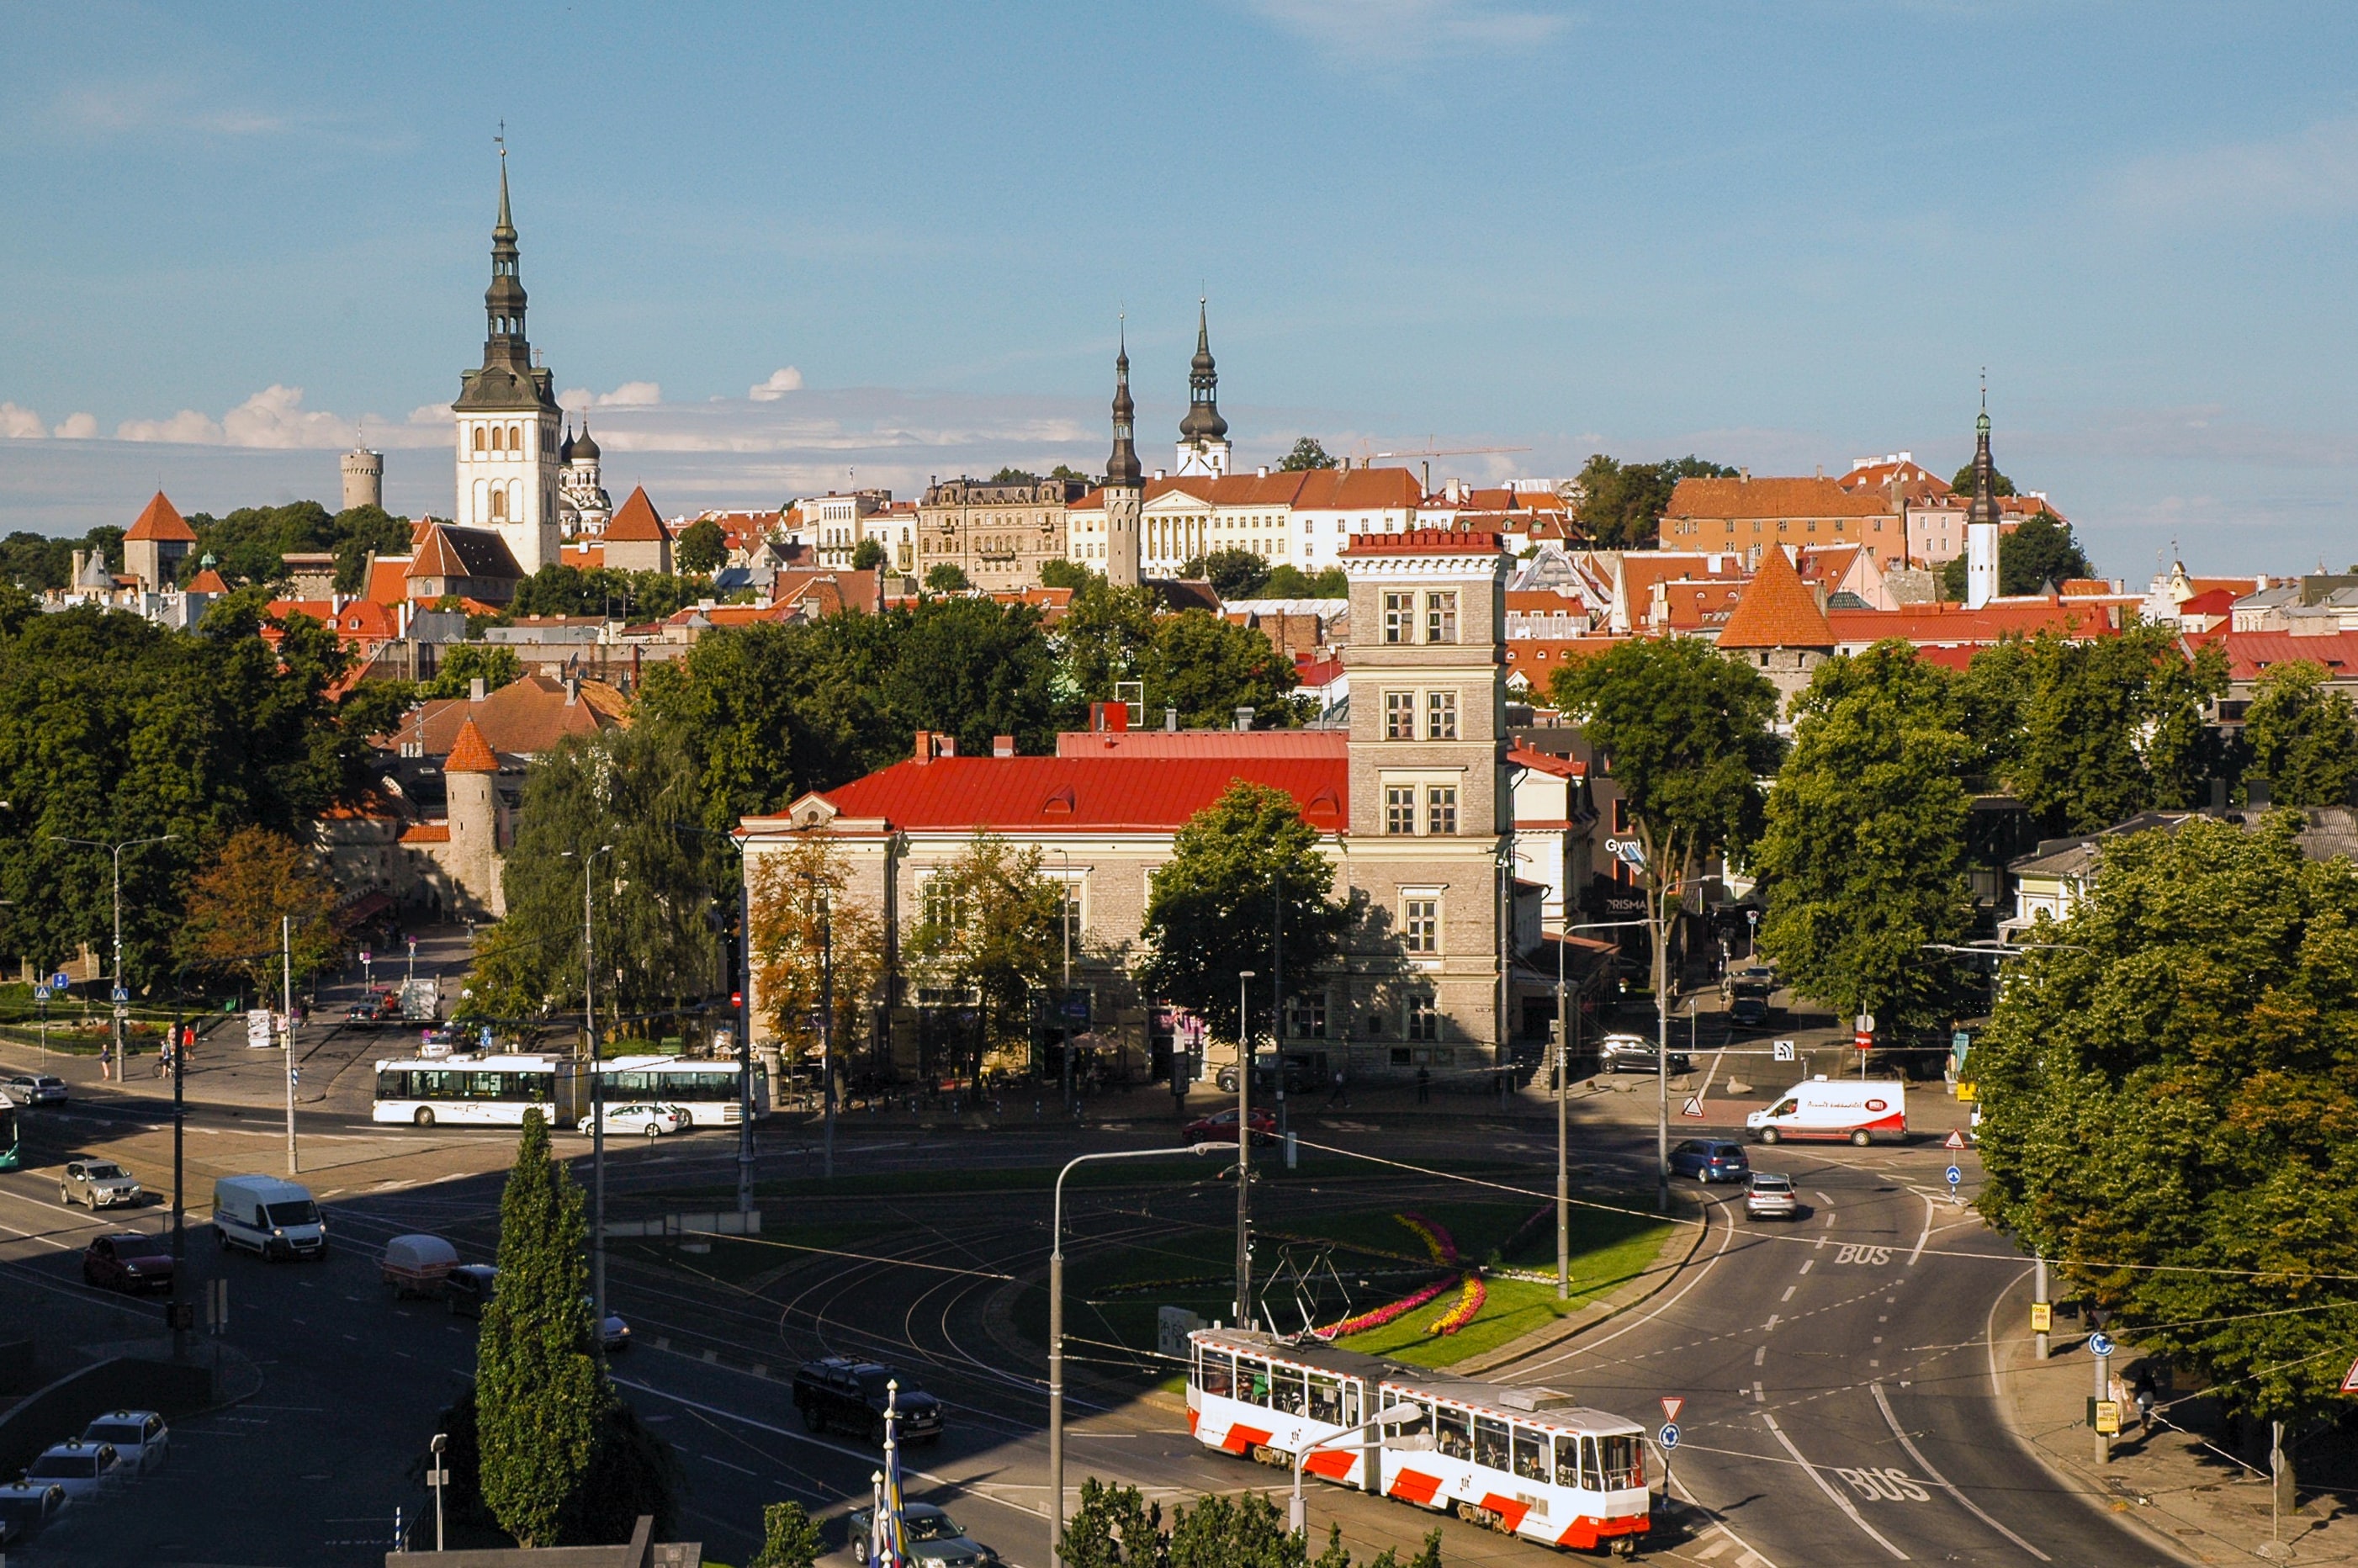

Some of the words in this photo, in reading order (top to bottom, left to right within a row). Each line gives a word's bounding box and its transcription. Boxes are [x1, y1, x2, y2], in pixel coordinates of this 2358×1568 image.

[1606, 898, 1647, 911] PRISMA
[1834, 1245, 1892, 1265] BUS
[1835, 1467, 1931, 1502] BUS
